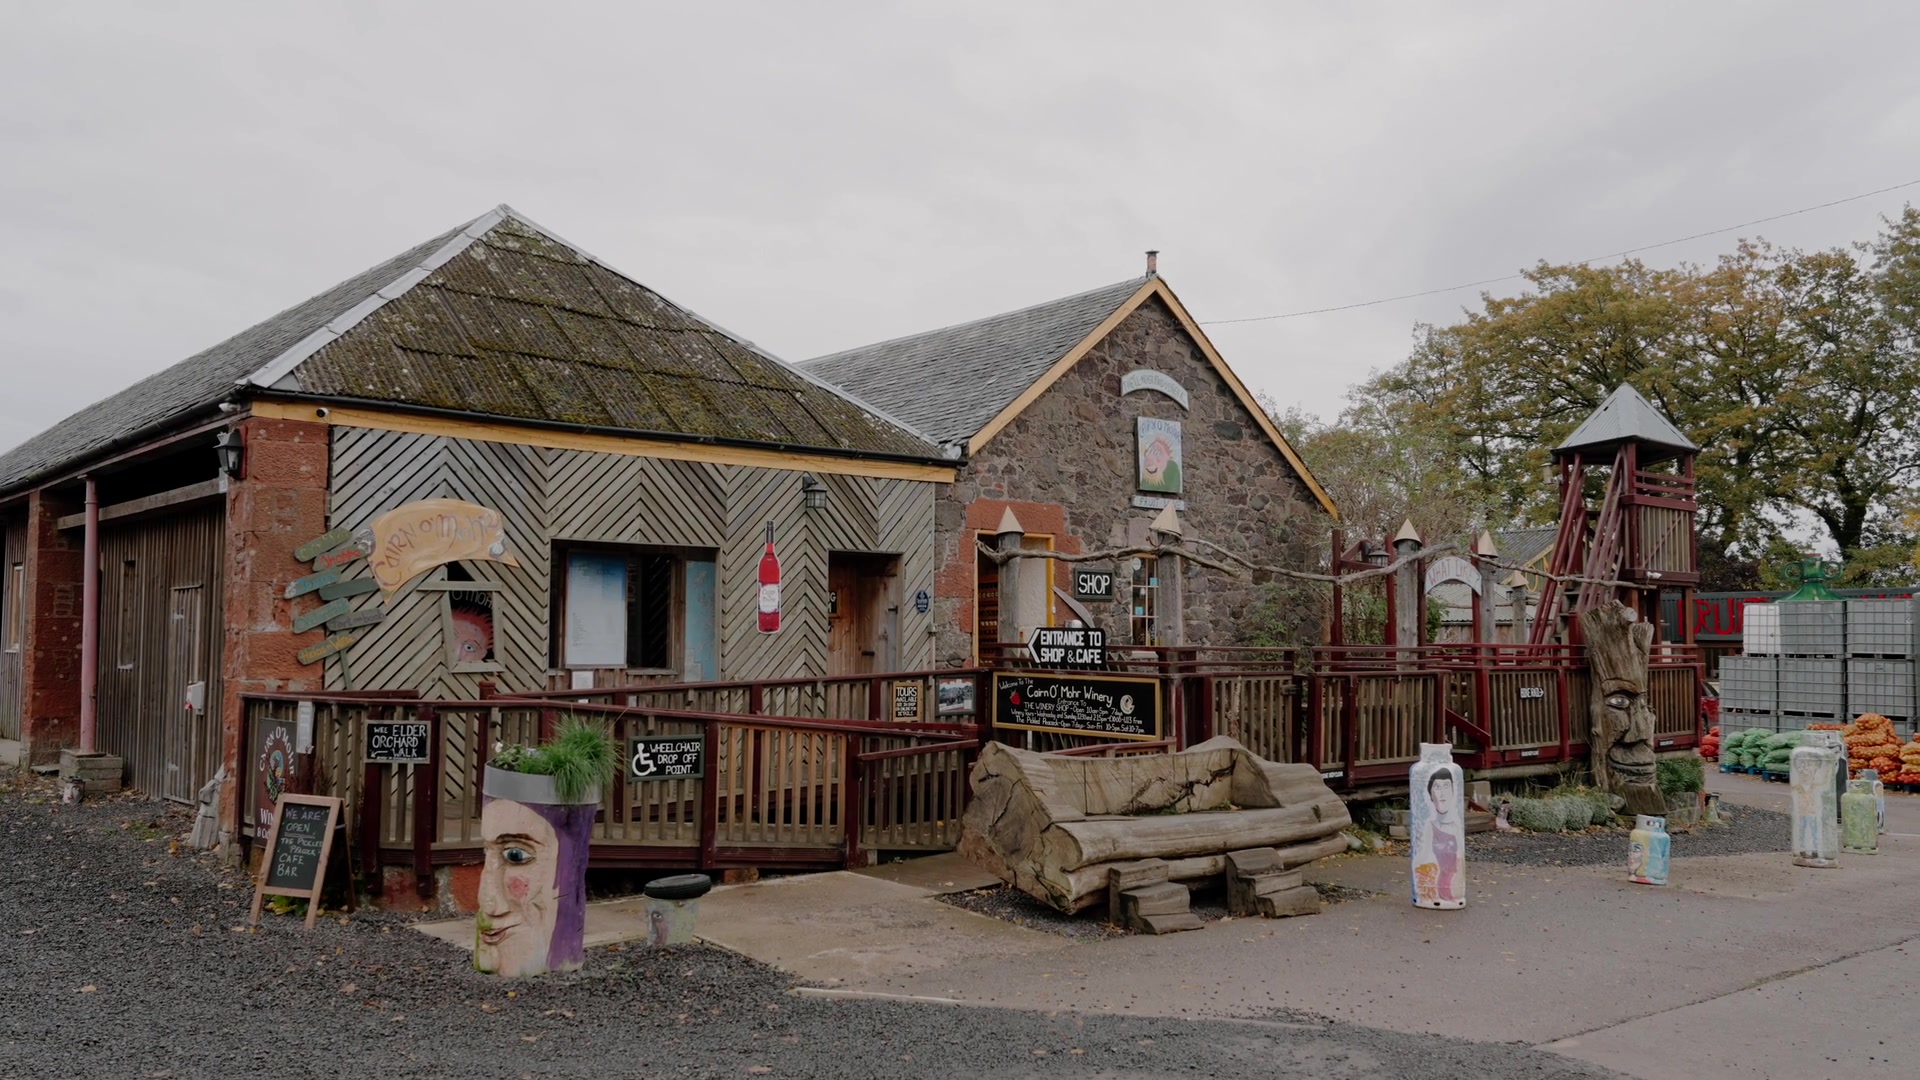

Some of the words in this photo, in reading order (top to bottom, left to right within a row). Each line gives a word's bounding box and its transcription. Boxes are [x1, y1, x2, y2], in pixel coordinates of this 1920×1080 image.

[1139, 497, 1160, 508] FRUIT
[374, 522, 417, 587] CAIRN
[1428, 558, 1451, 586] WHAT
[1078, 574, 1111, 595] SHOP
[1041, 631, 1085, 647] ENTRANCE
[1088, 631, 1102, 647] TO
[1041, 648, 1065, 663] SHOP
[1066, 650, 1077, 663] &
[1076, 648, 1102, 664] CAFE
[1018, 678, 1025, 686] To
[1024, 677, 1034, 685] The
[896, 686, 918, 697] TOURS
[1027, 685, 1049, 698] Cairn
[1060, 685, 1081, 699] Mohr
[1083, 685, 1114, 708] Winery
[1023, 701, 1035, 710] THE
[1035, 702, 1056, 712] WINERY
[1056, 704, 1070, 712] SHOP
[1057, 698, 1080, 706] Entrance
[373, 726, 388, 734] WEE
[392, 724, 426, 737] ELDER
[372, 735, 419, 749] ORCHARD
[649, 741, 701, 753] WHEELCHAIR
[392, 748, 418, 758] WALK
[657, 754, 678, 764] DROP
[682, 753, 698, 763] OFF
[665, 764, 695, 775] POINT.
[286, 808, 298, 820] WE
[302, 810, 321, 821] ARE
[286, 822, 311, 833] OPEN
[279, 853, 304, 865] CAFE
[276, 863, 298, 877] BAR
